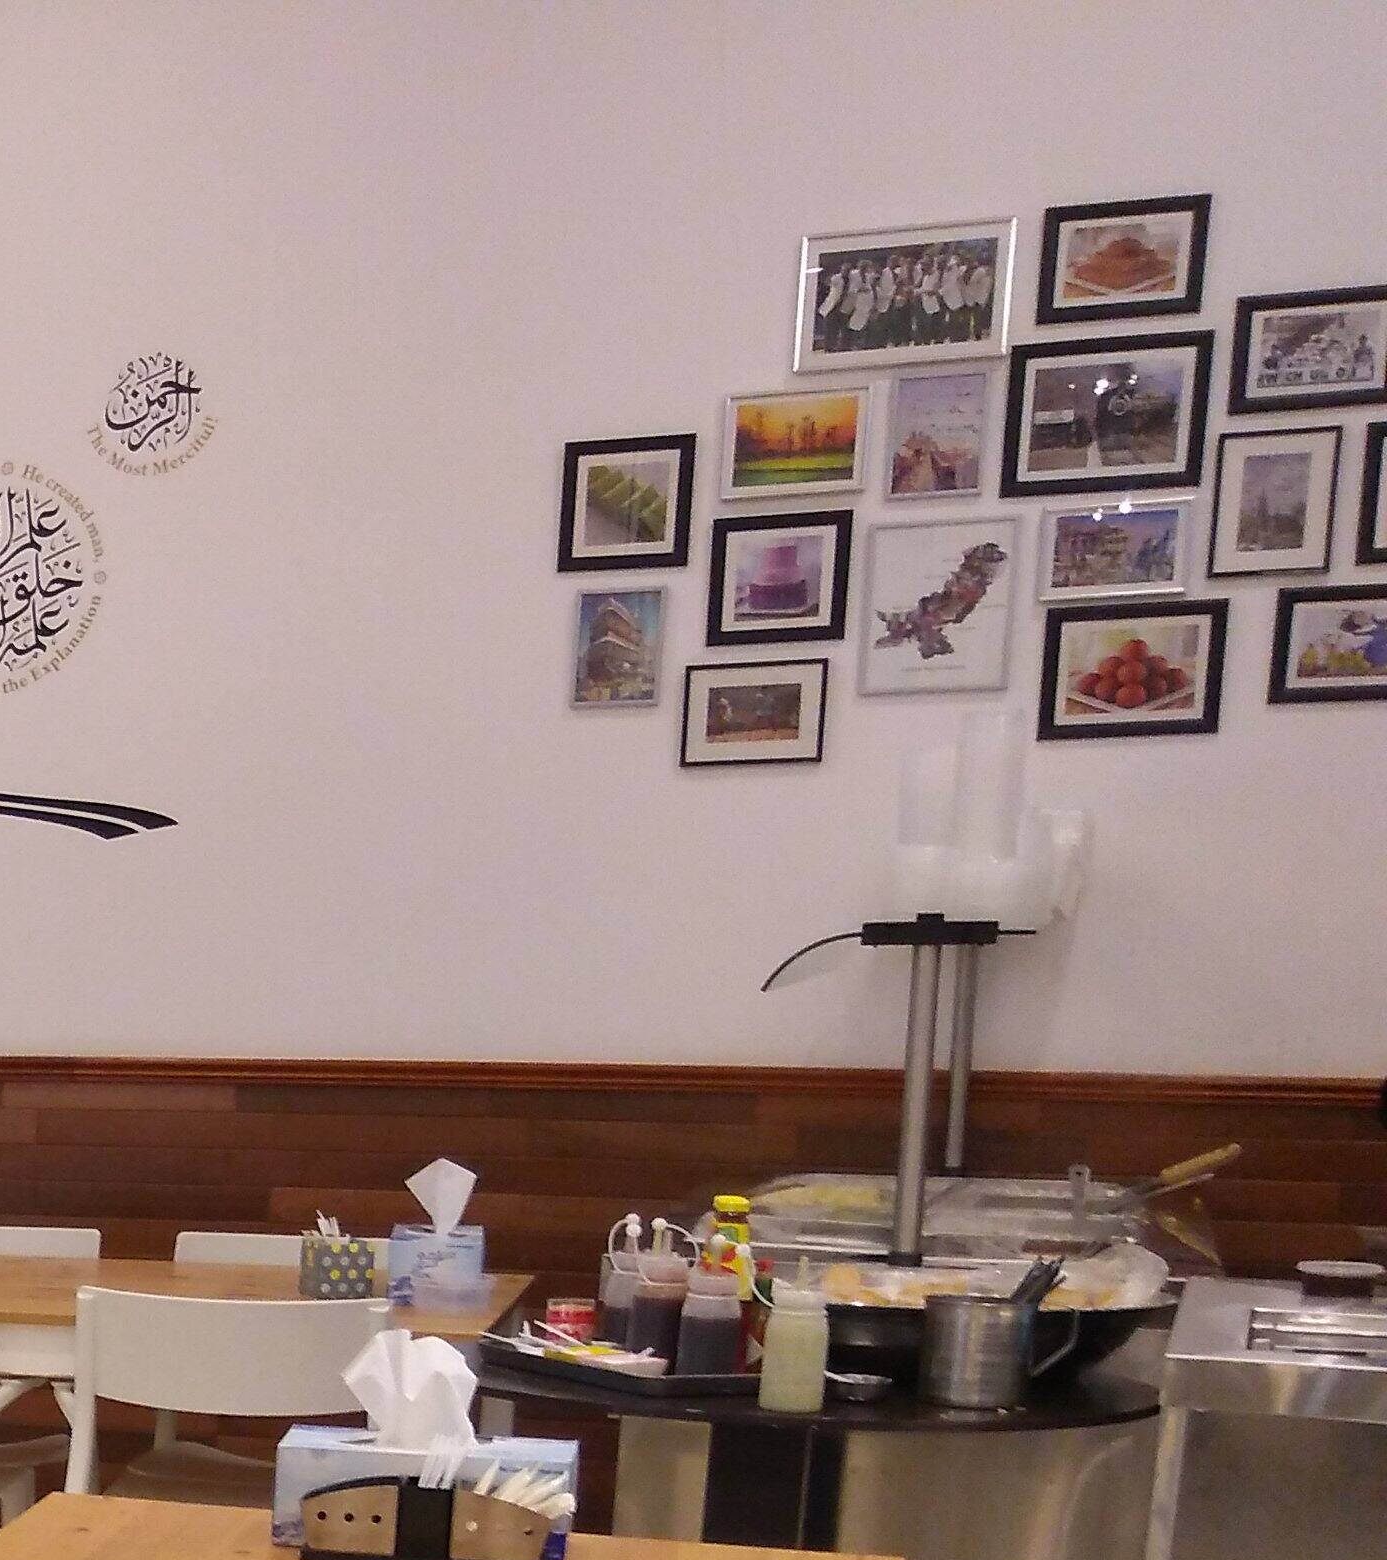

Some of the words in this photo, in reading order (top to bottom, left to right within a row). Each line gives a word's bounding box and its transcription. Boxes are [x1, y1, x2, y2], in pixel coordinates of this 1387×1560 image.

[86, 424, 107, 456] The
[110, 452, 148, 476] Most
[22, 464, 44, 484] He
[46, 478, 95, 522] created
[2, 678, 28, 695] the
[29, 595, 102, 681] Explanation
